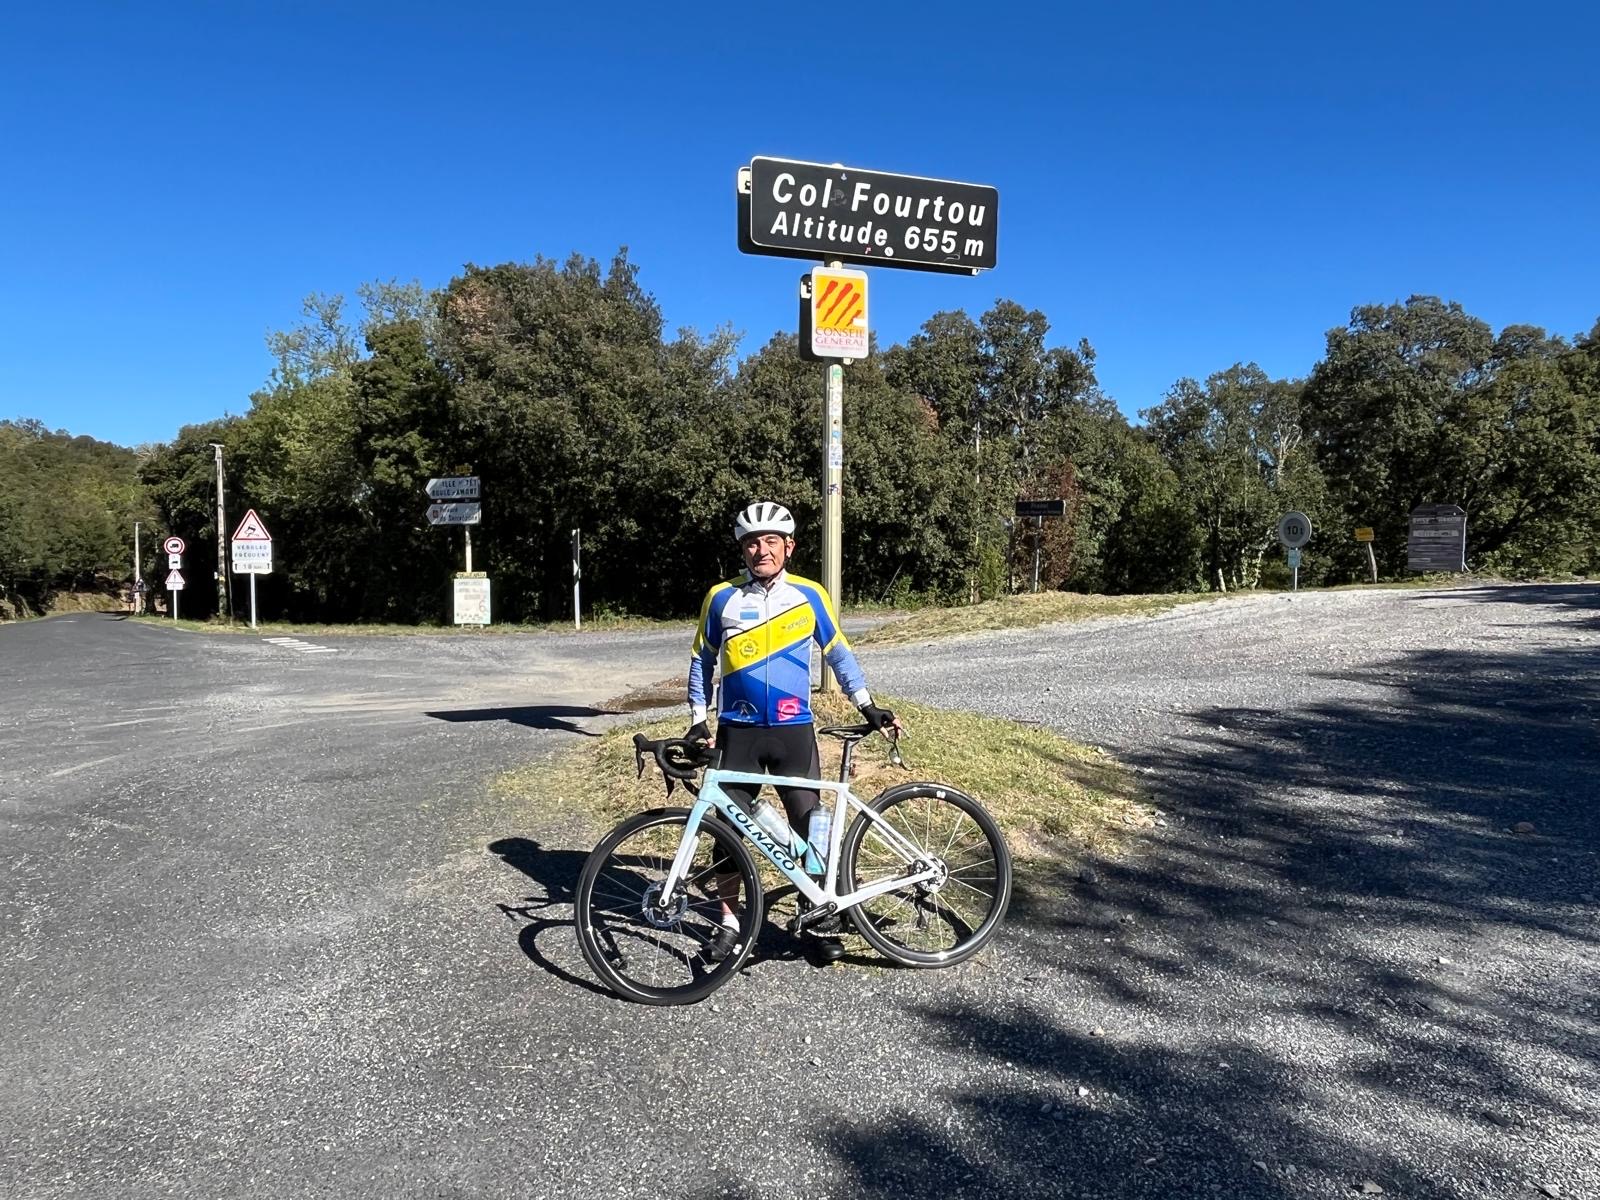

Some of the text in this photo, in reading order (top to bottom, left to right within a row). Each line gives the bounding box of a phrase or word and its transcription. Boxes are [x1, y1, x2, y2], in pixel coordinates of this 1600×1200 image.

[772, 173, 986, 227] Col Fourtou
[770, 211, 984, 257] Altitude 655 m
[815, 326, 864, 338] CONSEIL
[726, 803, 796, 872] COLNAGO
